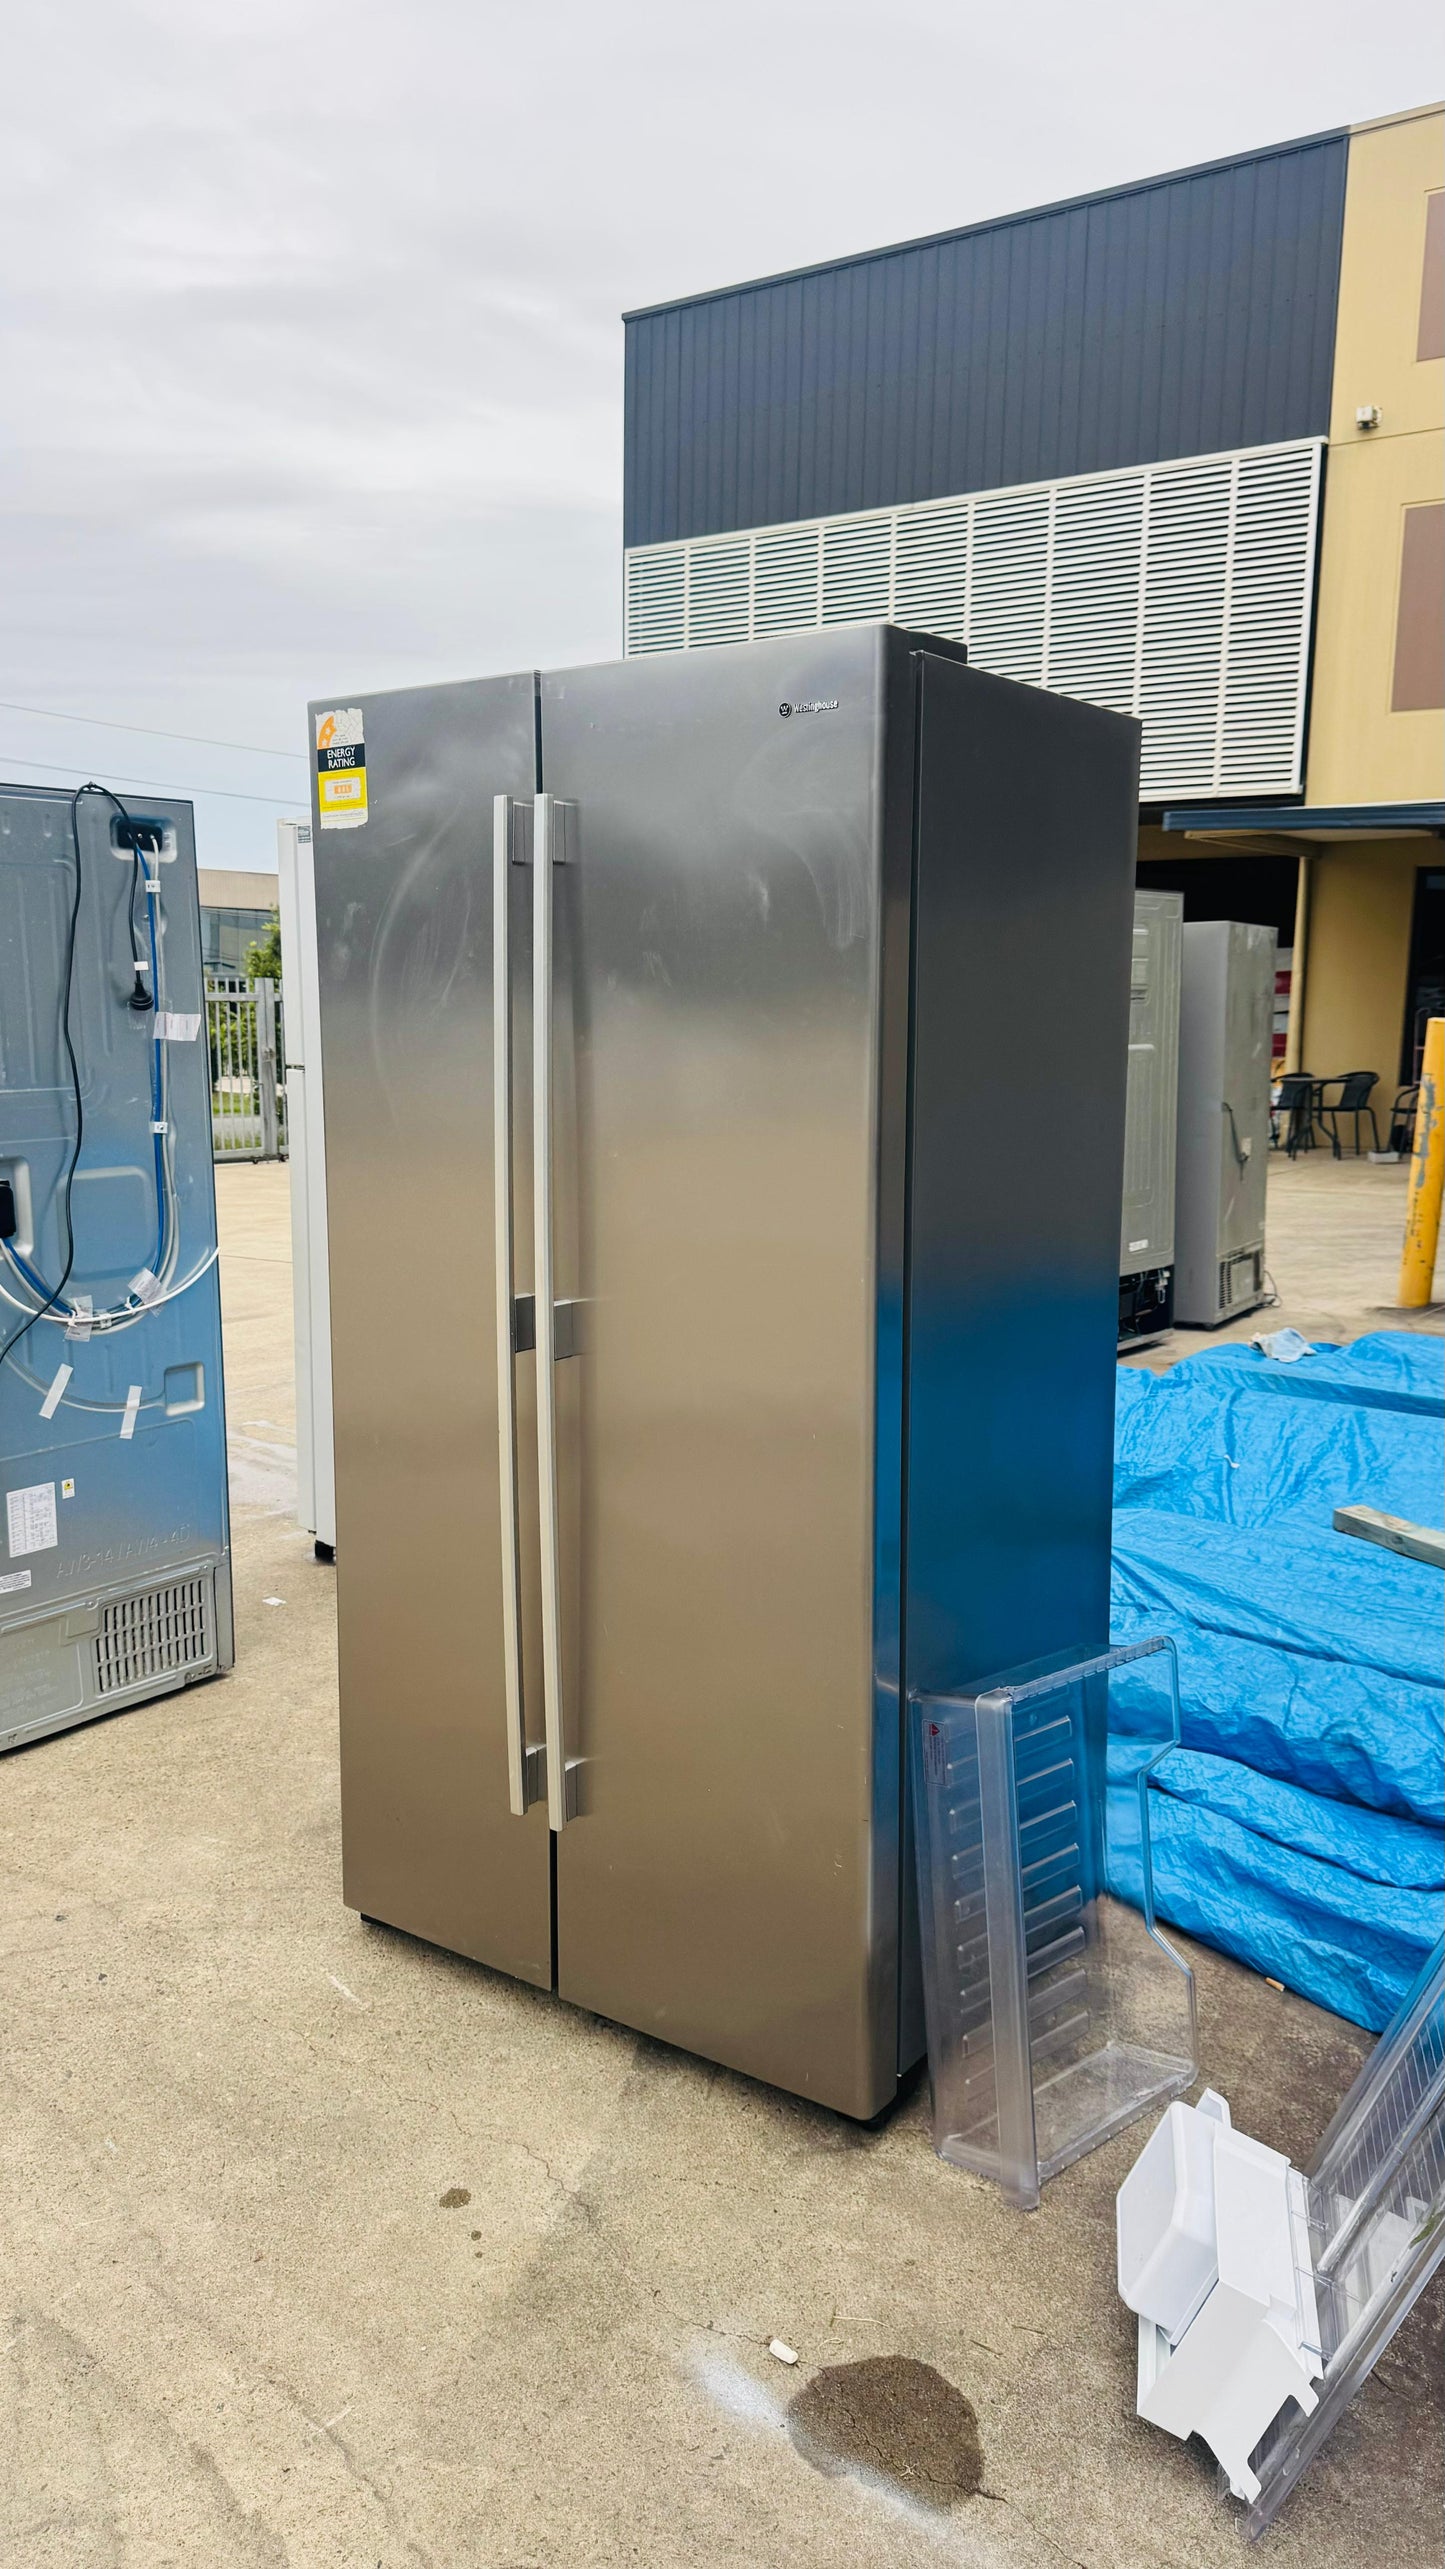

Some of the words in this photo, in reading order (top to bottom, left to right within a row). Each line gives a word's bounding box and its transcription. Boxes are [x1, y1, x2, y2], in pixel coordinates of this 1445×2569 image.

[794, 700, 839, 713] Westinghouse
[327, 746, 355, 759] ENERGY
[328, 757, 355, 769] RATING
